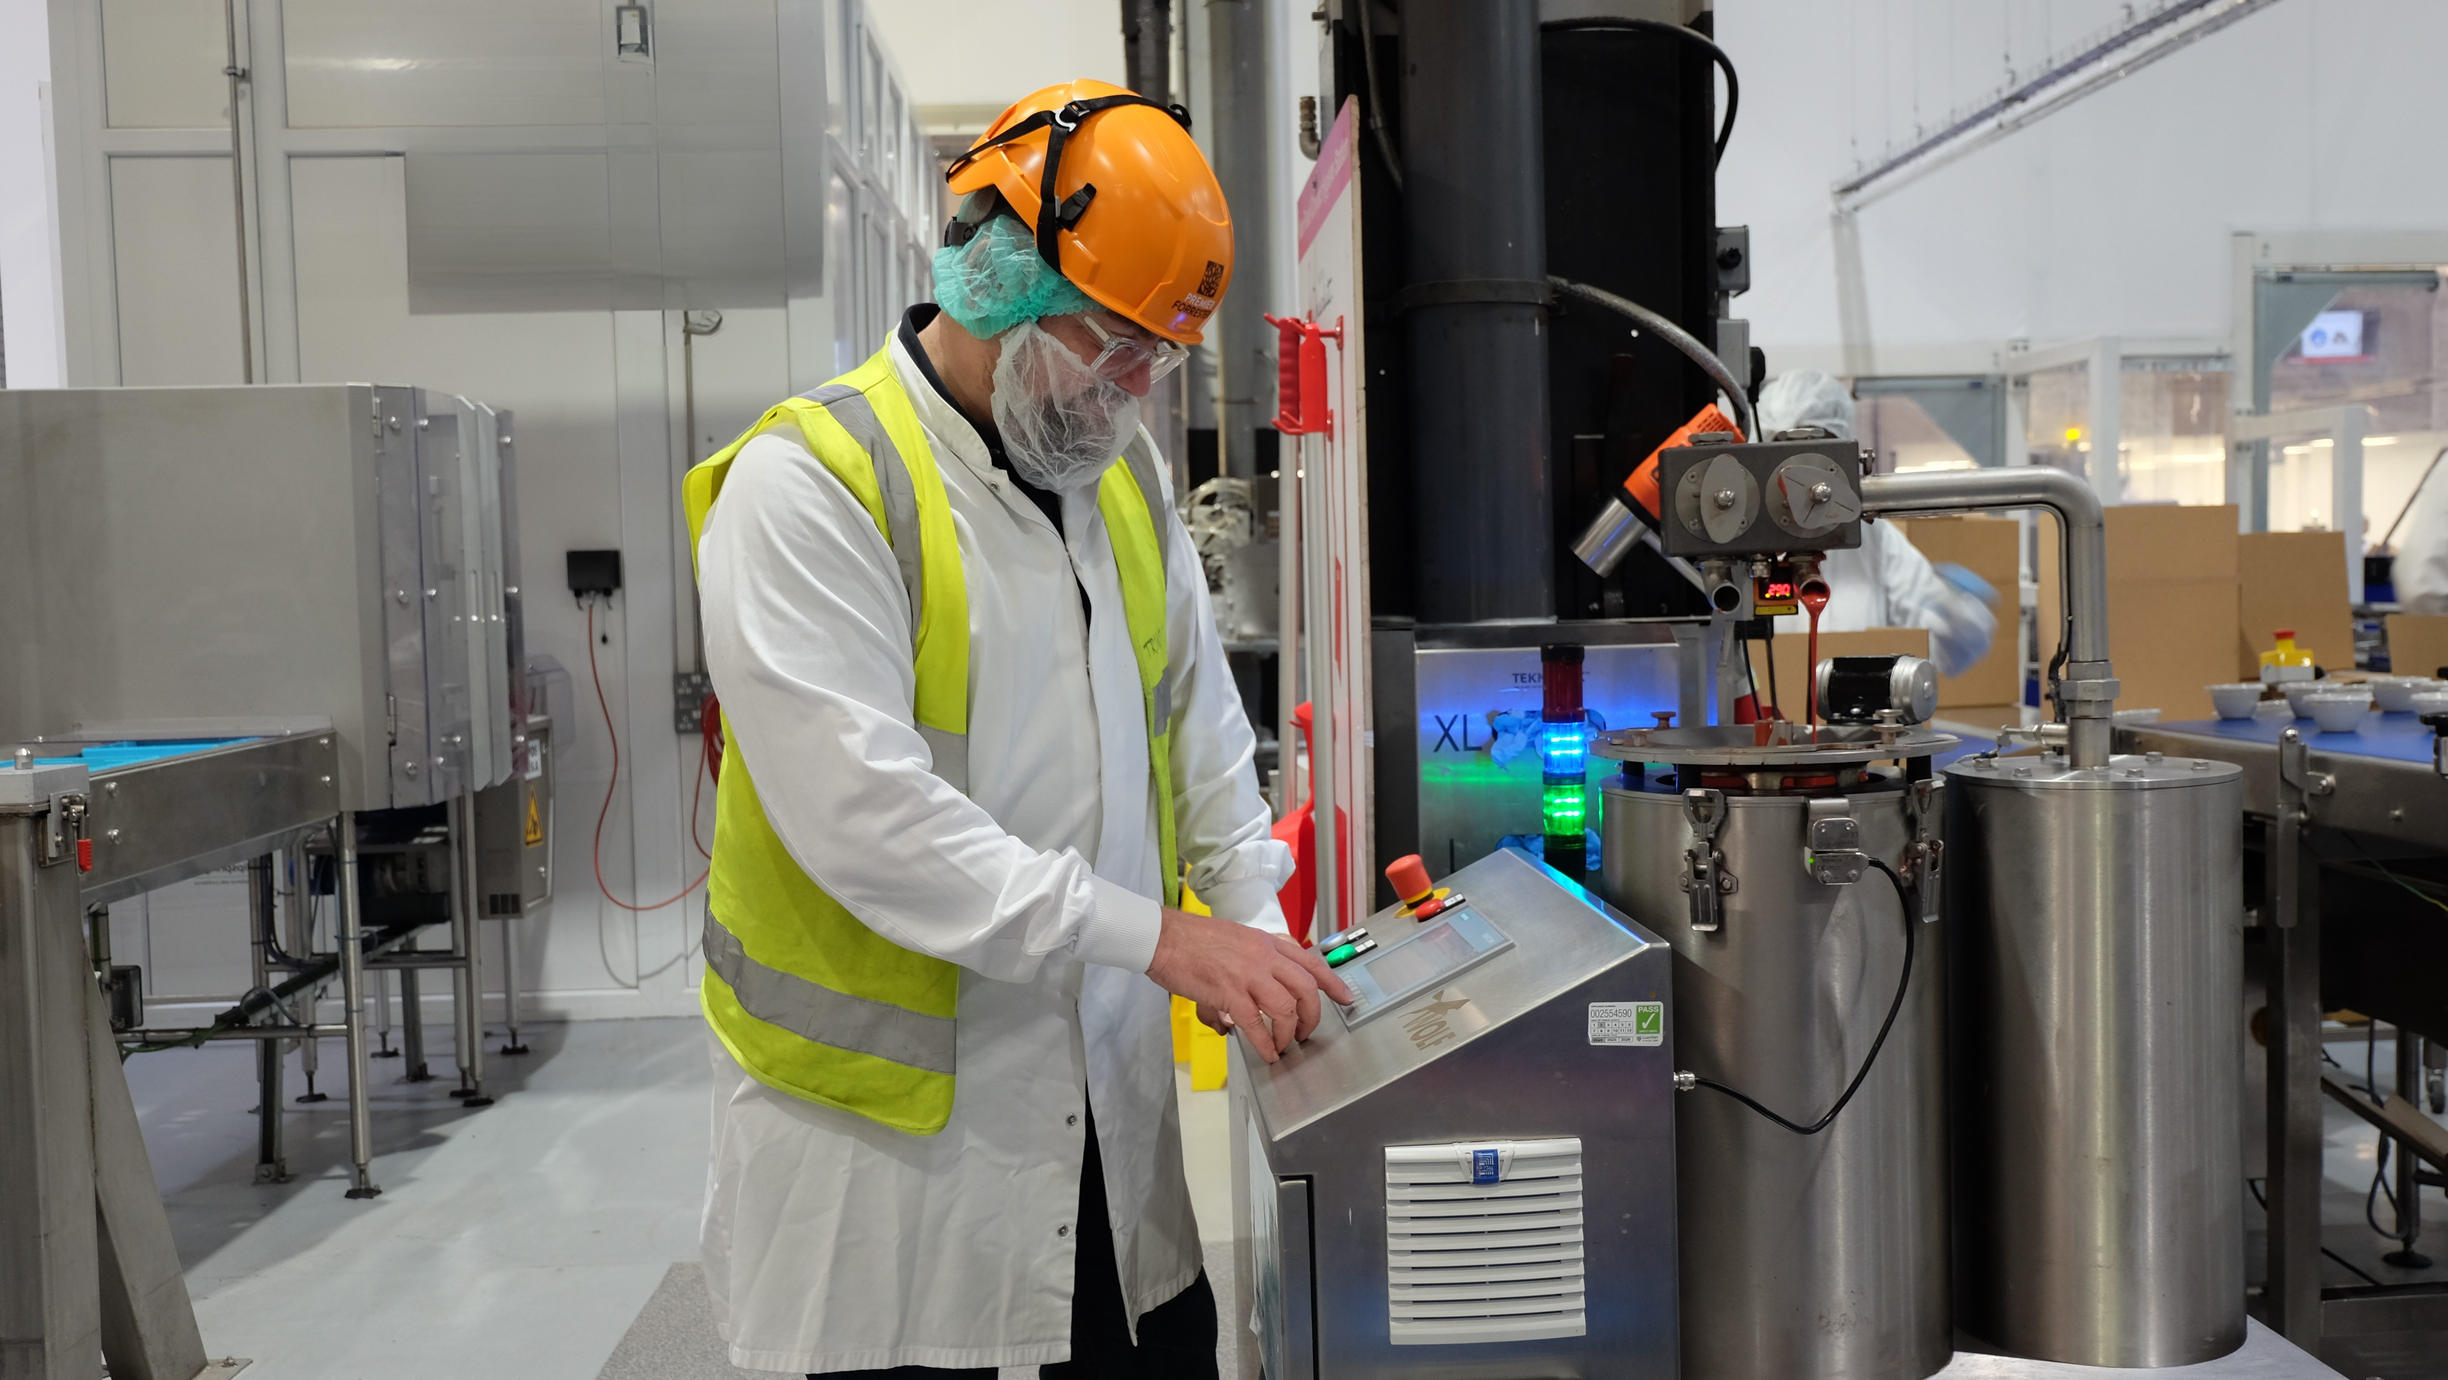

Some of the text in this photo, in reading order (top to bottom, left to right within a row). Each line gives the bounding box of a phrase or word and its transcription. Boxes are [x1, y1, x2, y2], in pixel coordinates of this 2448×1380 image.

[1433, 714, 1483, 753] XL
[1402, 1008, 1457, 1051] WOLF
[1591, 1009, 1632, 1018] 002554590
